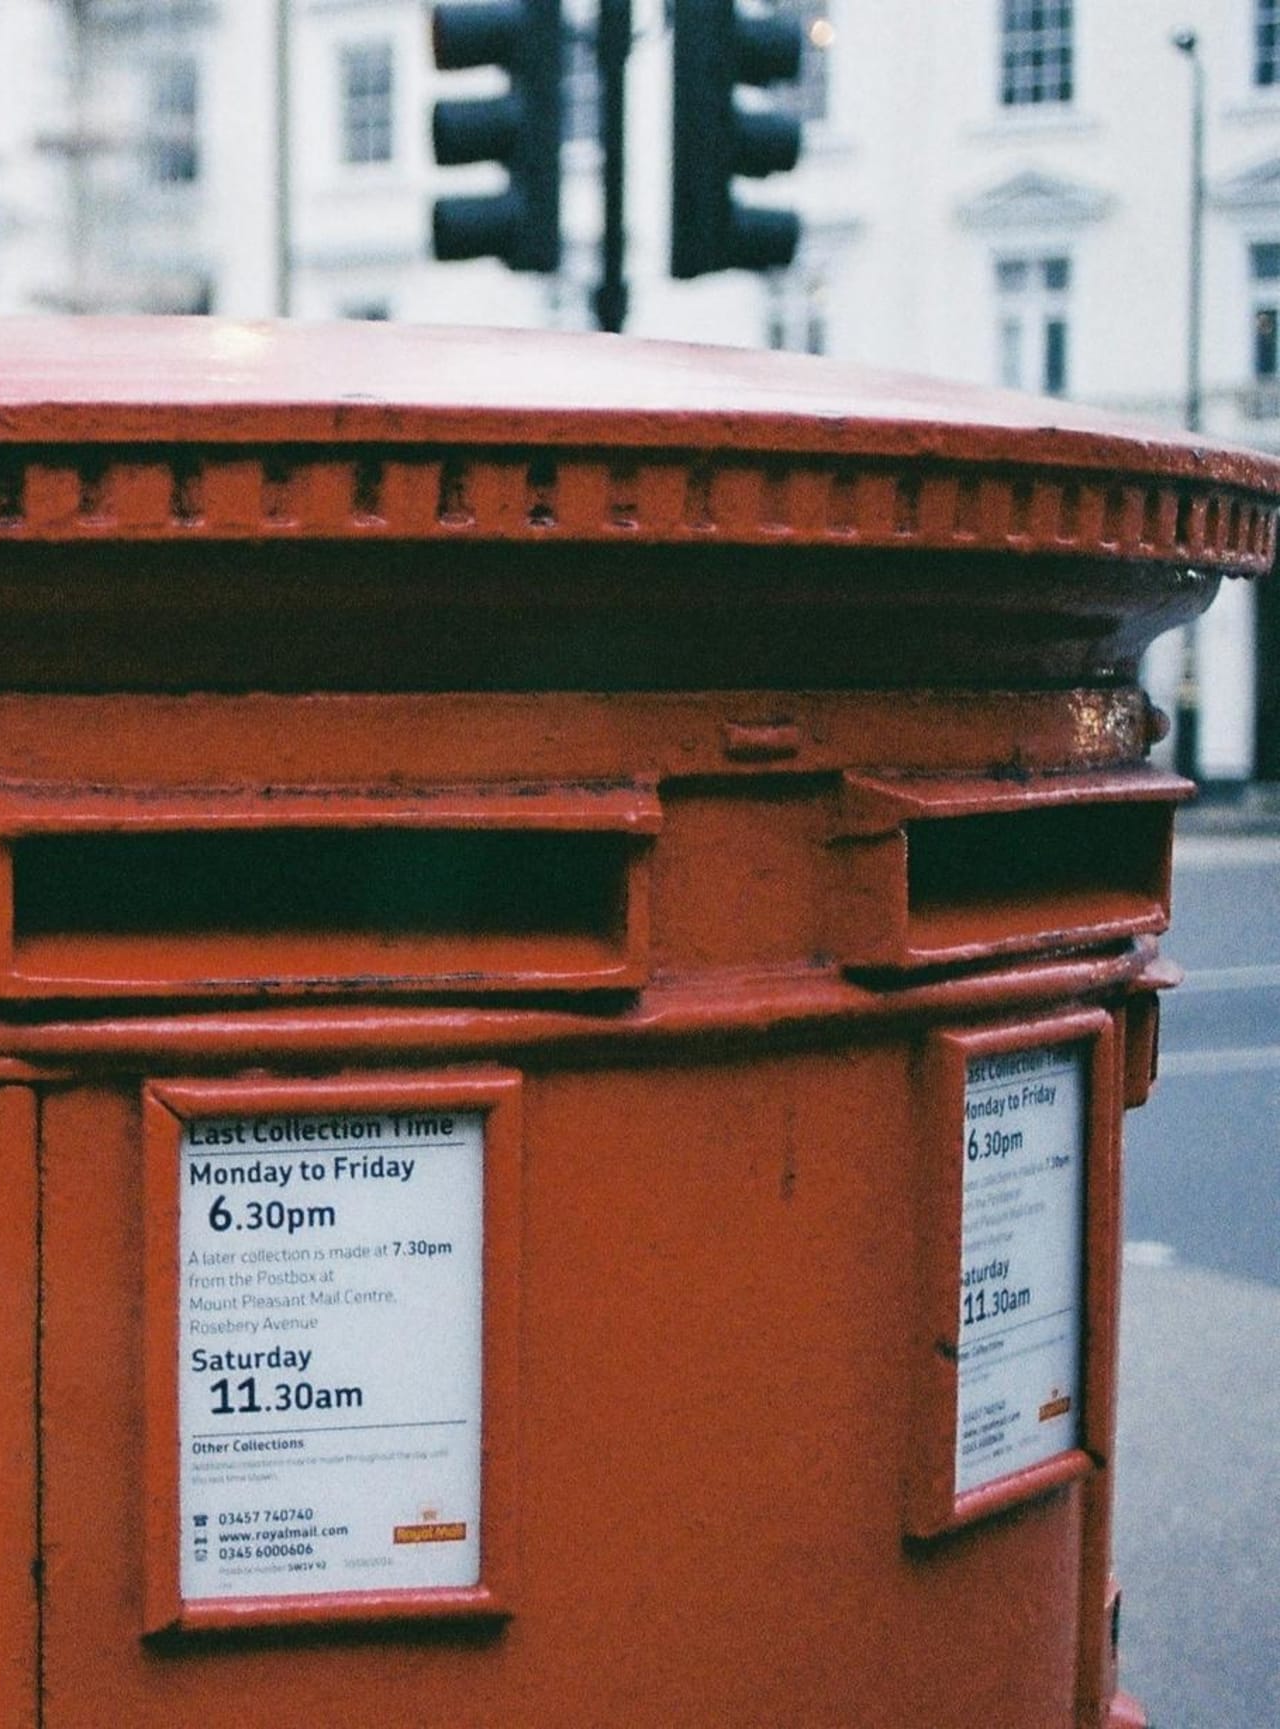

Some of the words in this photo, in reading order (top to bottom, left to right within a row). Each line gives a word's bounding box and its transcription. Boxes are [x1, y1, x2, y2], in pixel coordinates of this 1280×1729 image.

[1008, 1094, 1020, 1111] to
[1022, 1084, 1057, 1108] Friday
[188, 1121, 246, 1146] Last
[253, 1117, 381, 1143] Collection
[390, 1113, 454, 1137] Time
[968, 1128, 1023, 1161] 6.30pm
[190, 1160, 293, 1187] Monday
[301, 1159, 326, 1180] to
[334, 1155, 415, 1180] Friday
[208, 1195, 336, 1235] 6.30pm
[188, 1250, 199, 1265] A
[202, 1251, 236, 1265] later
[241, 1248, 311, 1263] collection
[314, 1248, 325, 1260] is
[329, 1245, 370, 1259] made
[375, 1244, 388, 1257] at
[393, 1240, 453, 1257] 7.30pm
[188, 1272, 225, 1288] from
[228, 1271, 253, 1287] the
[257, 1269, 315, 1286] Postbox
[320, 1269, 335, 1283] at
[961, 1259, 1010, 1286] aturday
[189, 1296, 238, 1311] Mount
[242, 1293, 305, 1309] Pleasant
[309, 1290, 340, 1305] Mail
[964, 1286, 1031, 1326] 11.30am
[189, 1319, 259, 1335] Rosebery
[263, 1316, 319, 1331] Avenue
[192, 1346, 312, 1373] Saturday
[210, 1377, 363, 1415] 11.30am
[192, 1441, 230, 1455] Other
[233, 1438, 305, 1453] Collections
[219, 1511, 260, 1526] 03457
[263, 1507, 314, 1523] 740740
[219, 1525, 349, 1543] www.royalmail.com
[219, 1547, 252, 1561] 0345
[255, 1543, 314, 1558] 6000606
